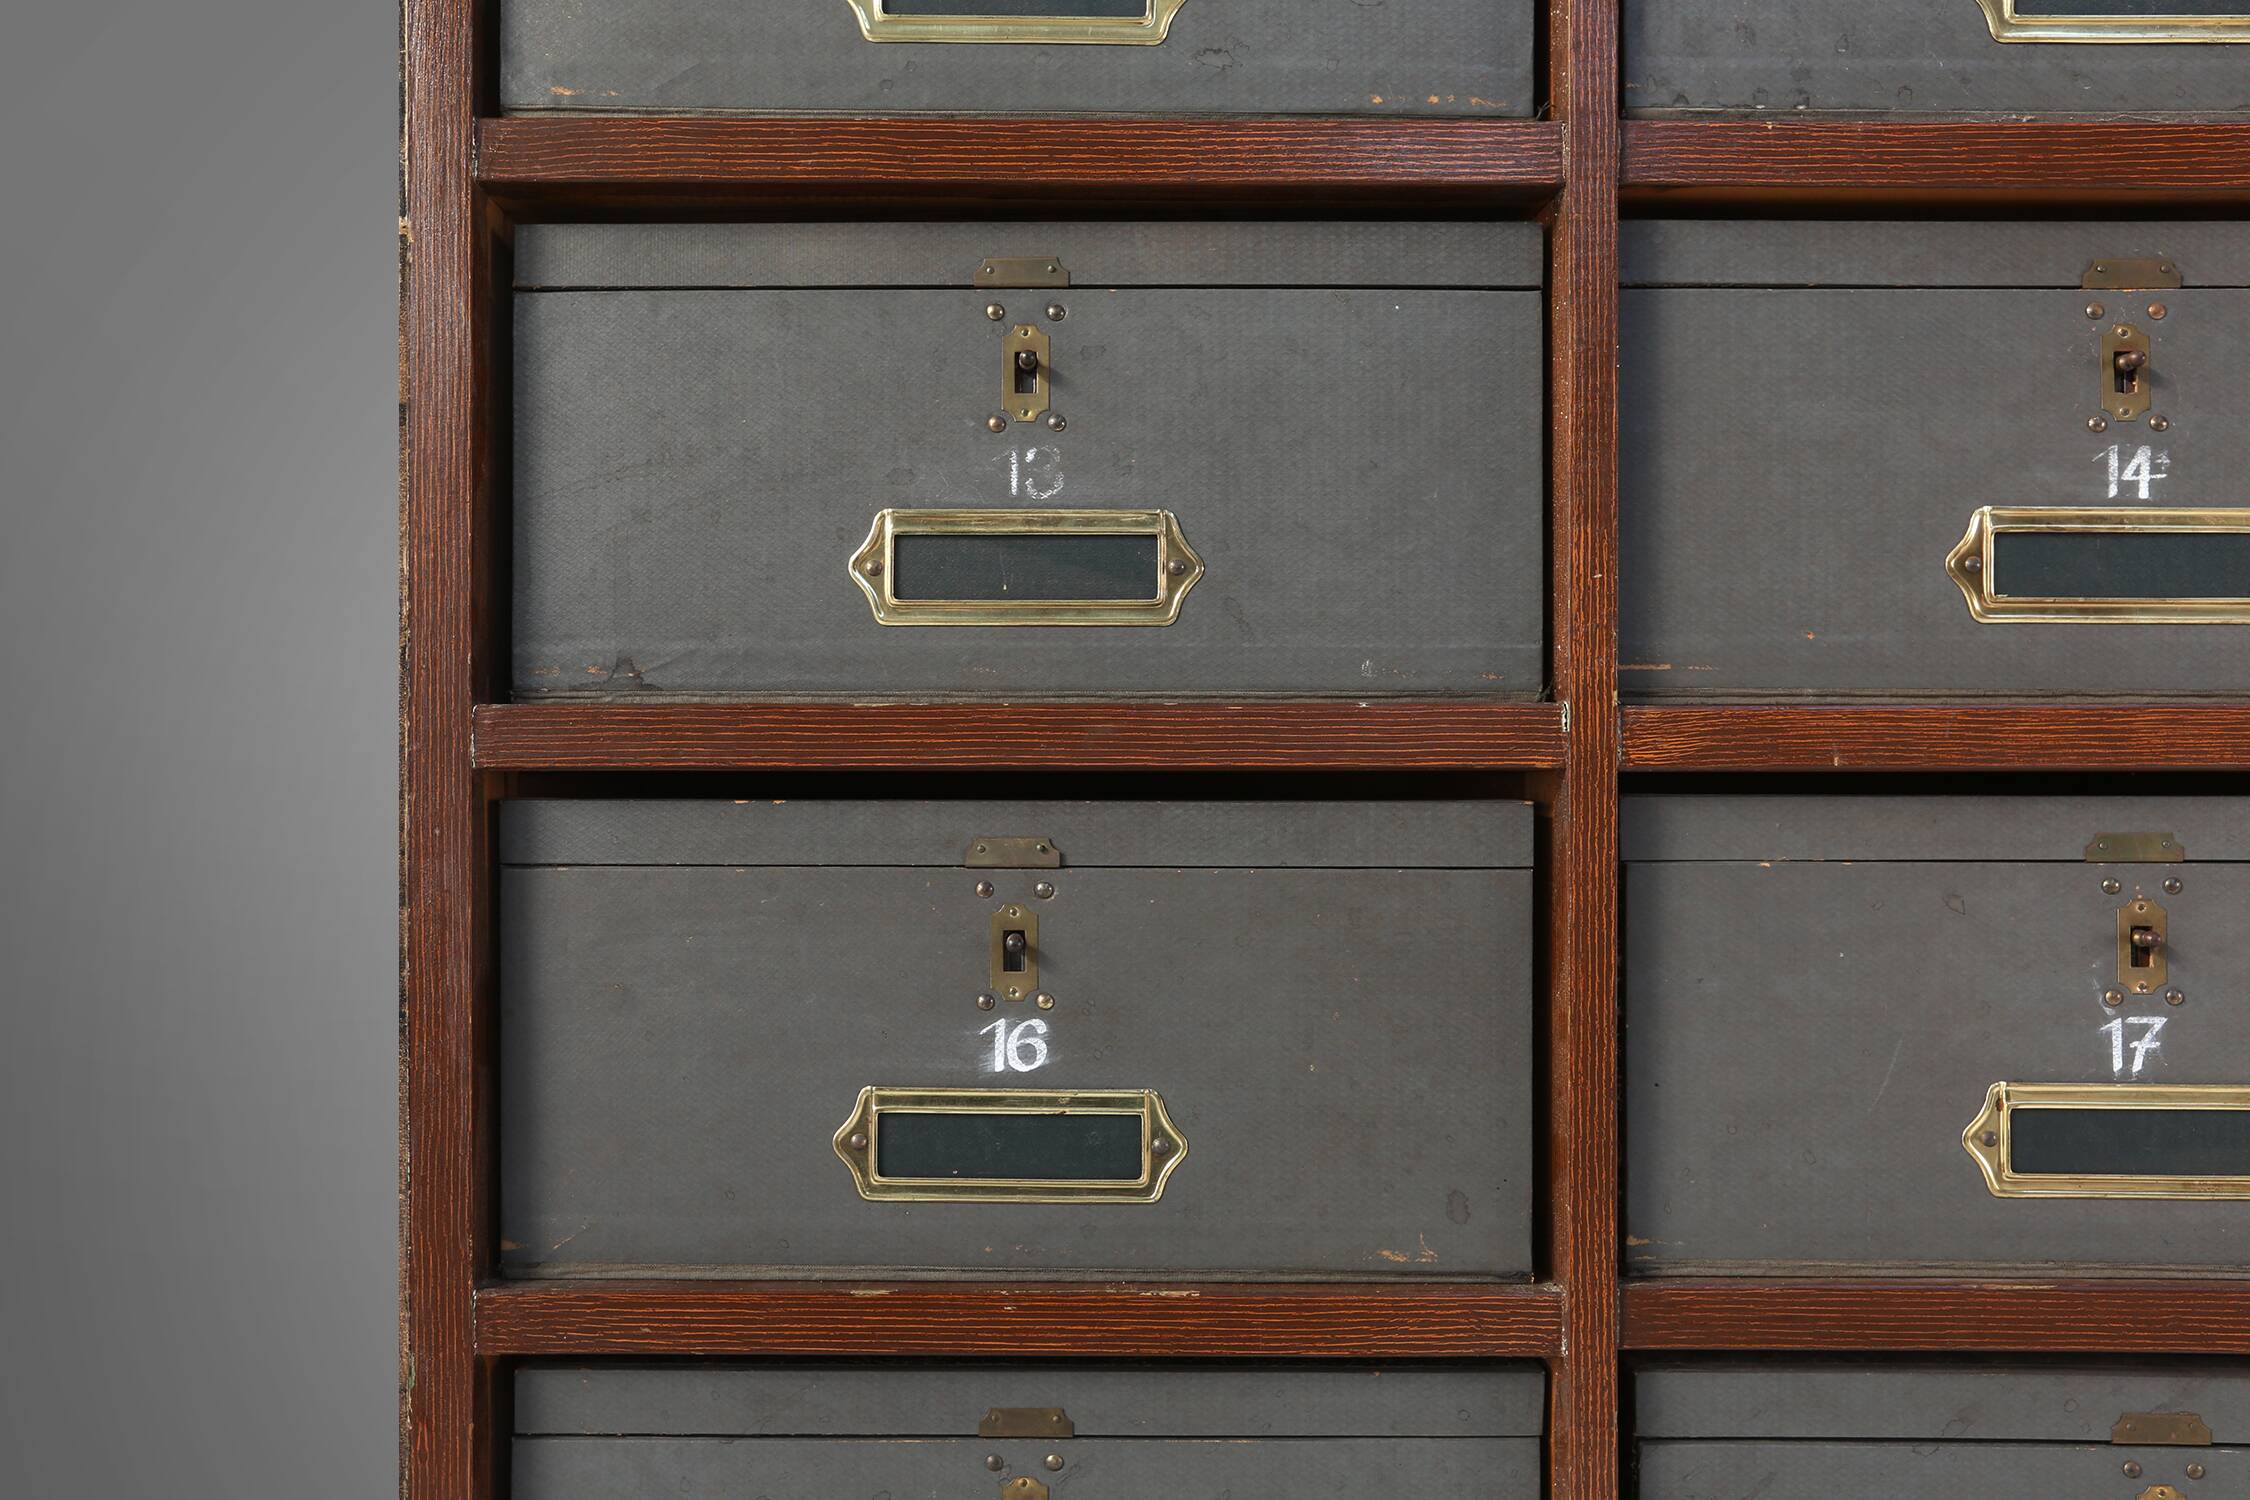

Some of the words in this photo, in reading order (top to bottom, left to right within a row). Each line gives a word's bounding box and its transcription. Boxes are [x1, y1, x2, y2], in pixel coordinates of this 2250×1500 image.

[994, 446, 1065, 500] 13
[2092, 444, 2168, 499] 14
[979, 1018, 1048, 1072] 16
[2099, 1016, 2168, 1073] 17
